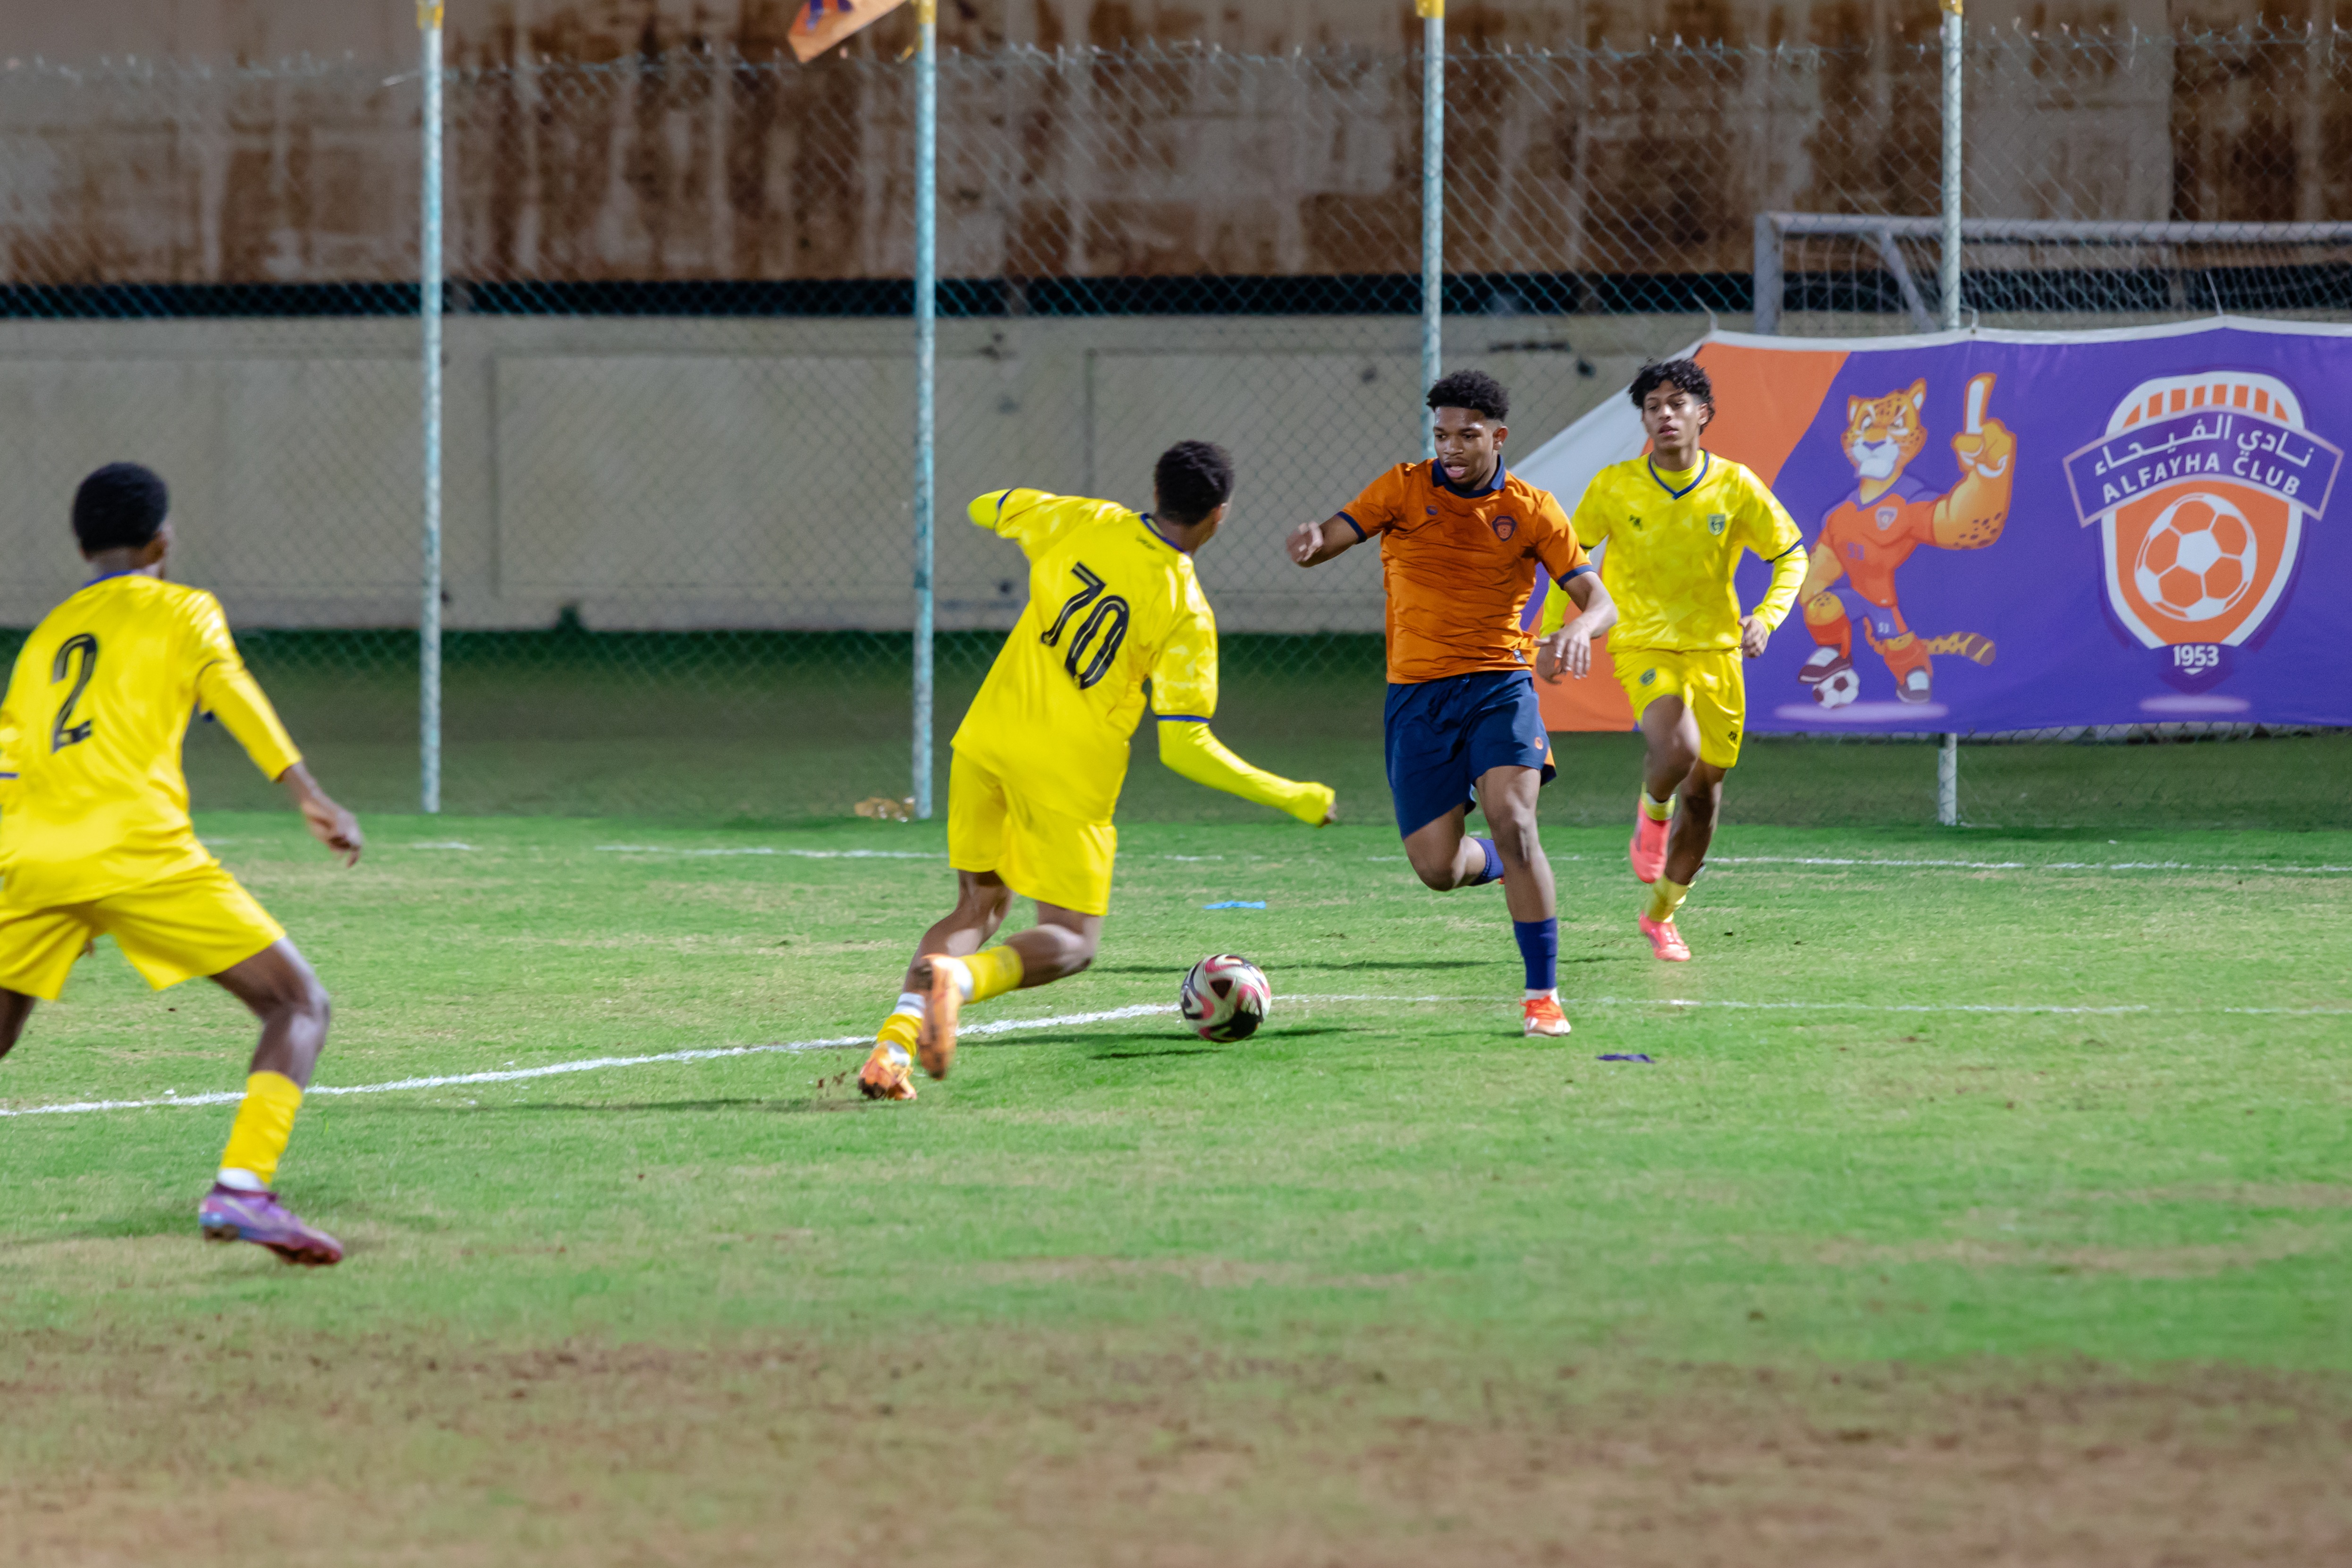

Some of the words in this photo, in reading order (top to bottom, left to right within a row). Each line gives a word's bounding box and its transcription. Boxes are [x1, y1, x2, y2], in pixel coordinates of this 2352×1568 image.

[2095, 414, 2233, 476] الفيحاء
[2237, 429, 2314, 468] نادي
[2102, 452, 2220, 504] ALFAYHA
[2233, 457, 2301, 496] CLUB
[1041, 561, 1129, 690] 70
[2173, 644, 2219, 667] 1953
[51, 633, 97, 754] 2
